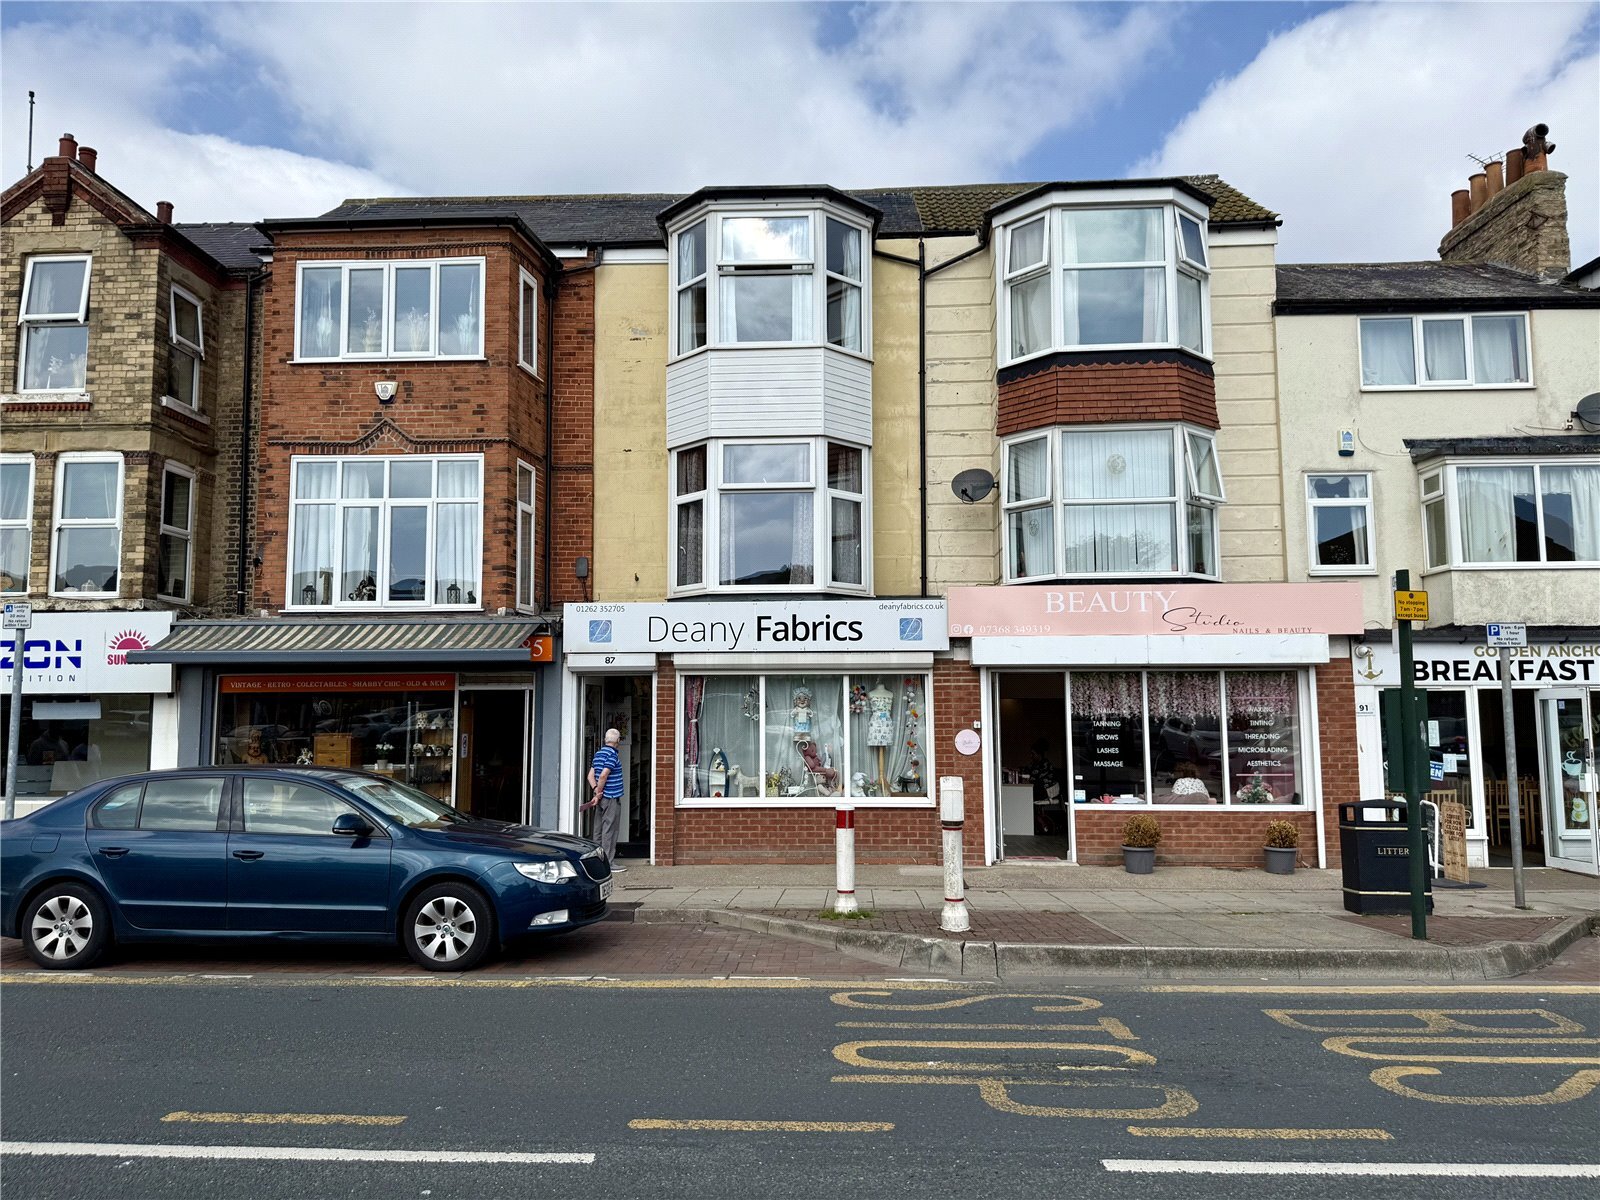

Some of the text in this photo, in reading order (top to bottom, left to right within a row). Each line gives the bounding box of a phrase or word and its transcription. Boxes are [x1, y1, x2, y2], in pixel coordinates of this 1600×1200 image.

[879, 602, 944, 611] deanyfabrics.co.uk
[1046, 591, 1177, 613] BEAUTY
[980, 624, 1051, 633] 07368 349319
[1162, 607, 1244, 632] Studio
[649, 614, 863, 650] Deany Fabrics
[1474, 646, 1541, 657] GODEN
[1413, 659, 1594, 681] BREAKFAST
